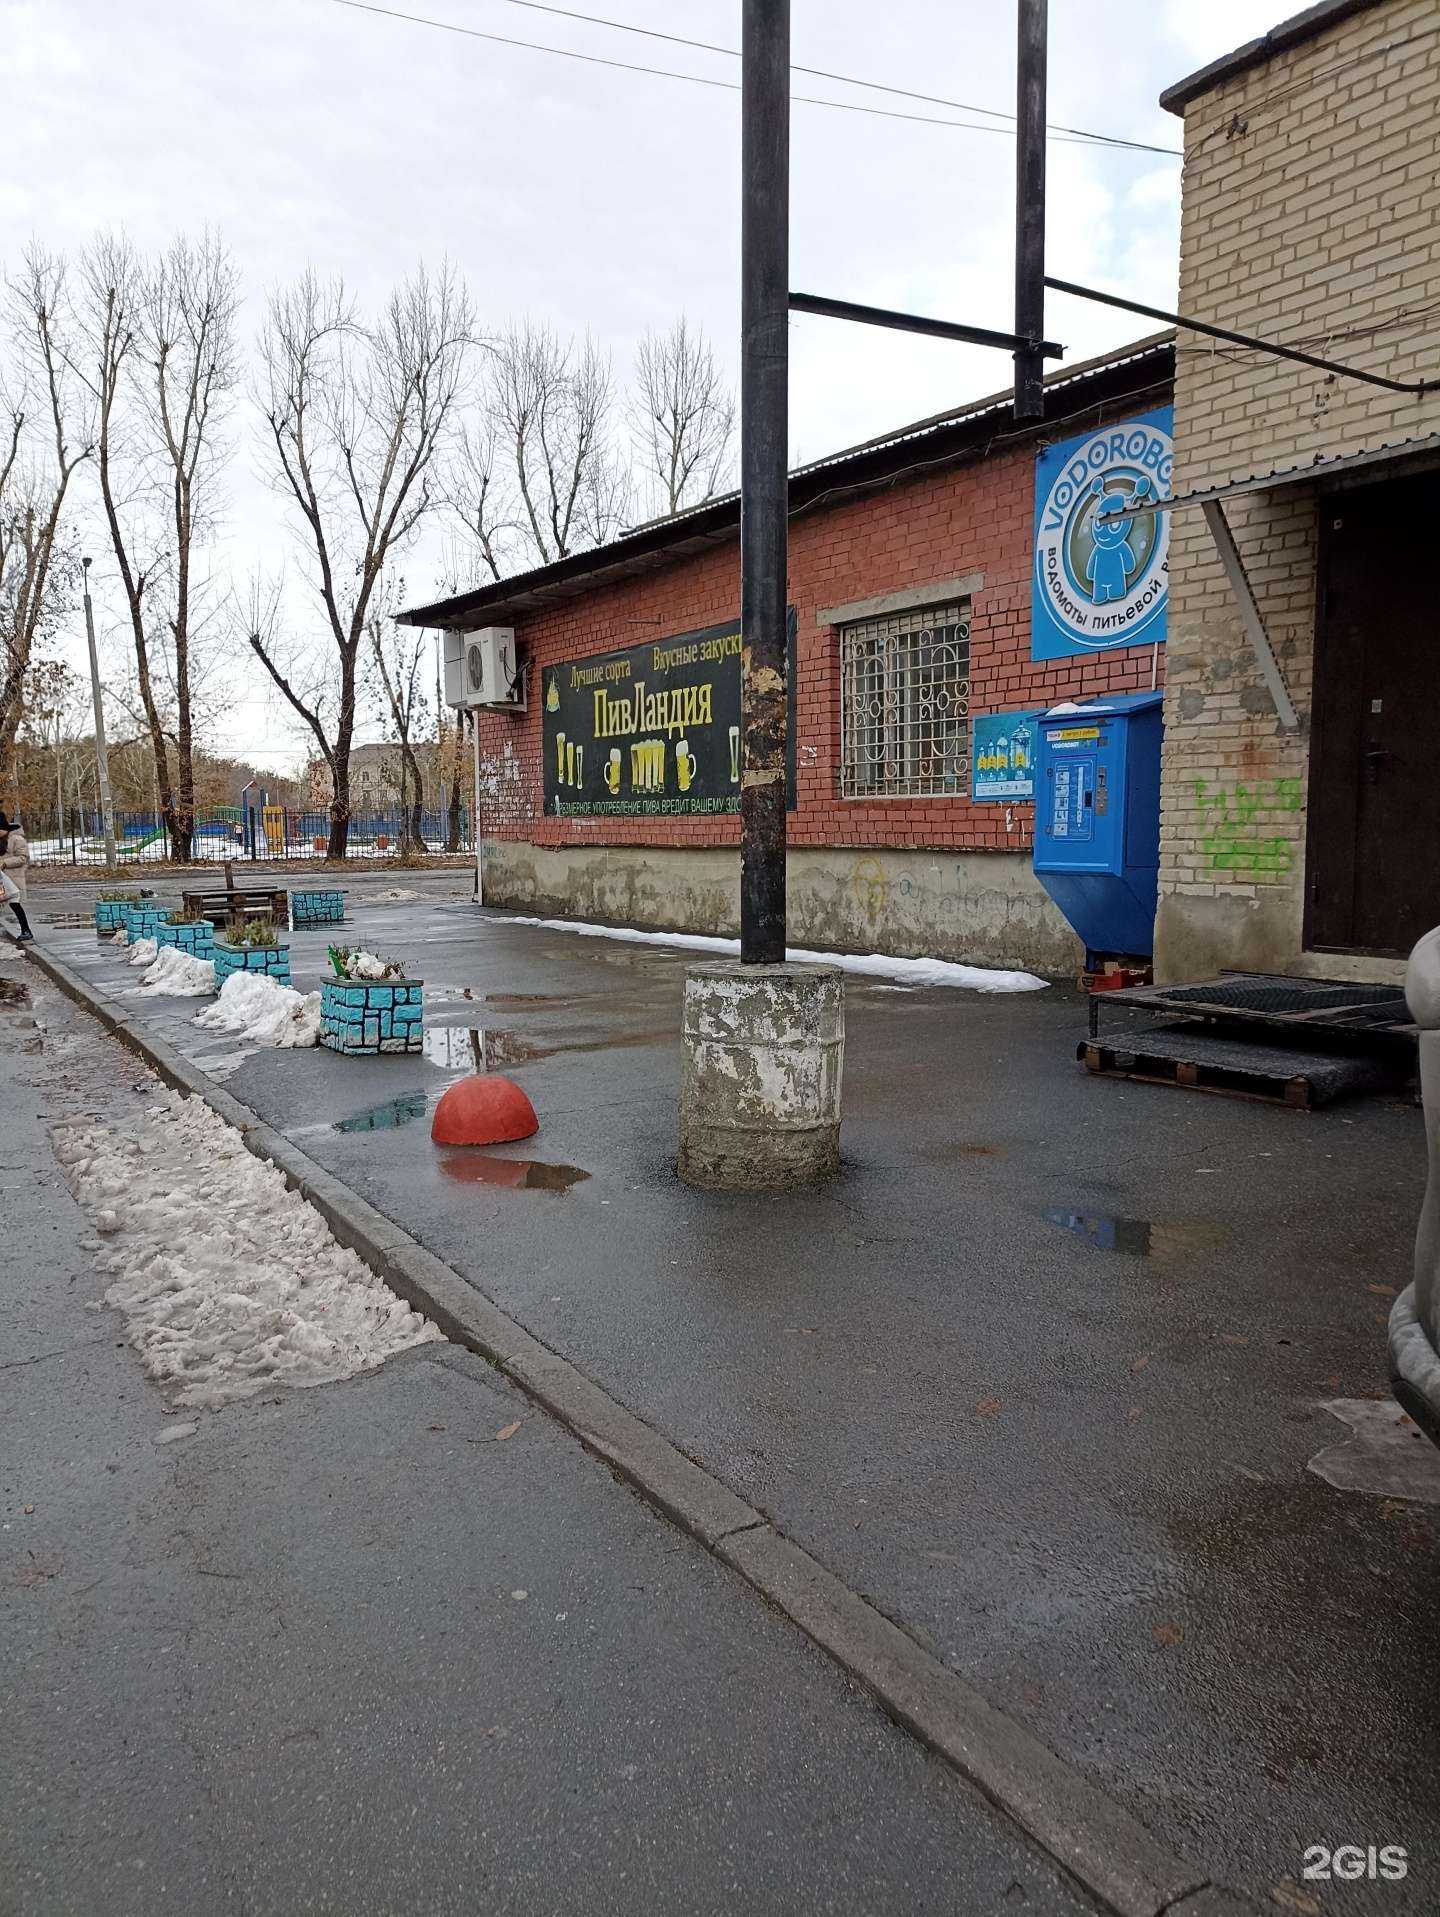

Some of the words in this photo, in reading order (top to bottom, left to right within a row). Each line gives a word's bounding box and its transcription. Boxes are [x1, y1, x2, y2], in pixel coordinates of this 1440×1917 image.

[1043, 430, 1173, 531] VODOROBO
[653, 644, 698, 675] Вкусные
[570, 664, 604, 692] Лучшие
[605, 660, 631, 686] сорта
[593, 681, 713, 740] ПивЛандия
[593, 800, 642, 814] УПОТРЕБЛЕНИЕ
[642, 800, 661, 814] ПИВА
[661, 798, 690, 814] ВРЕДИТ
[691, 797, 724, 813] ВАШЕМУ
